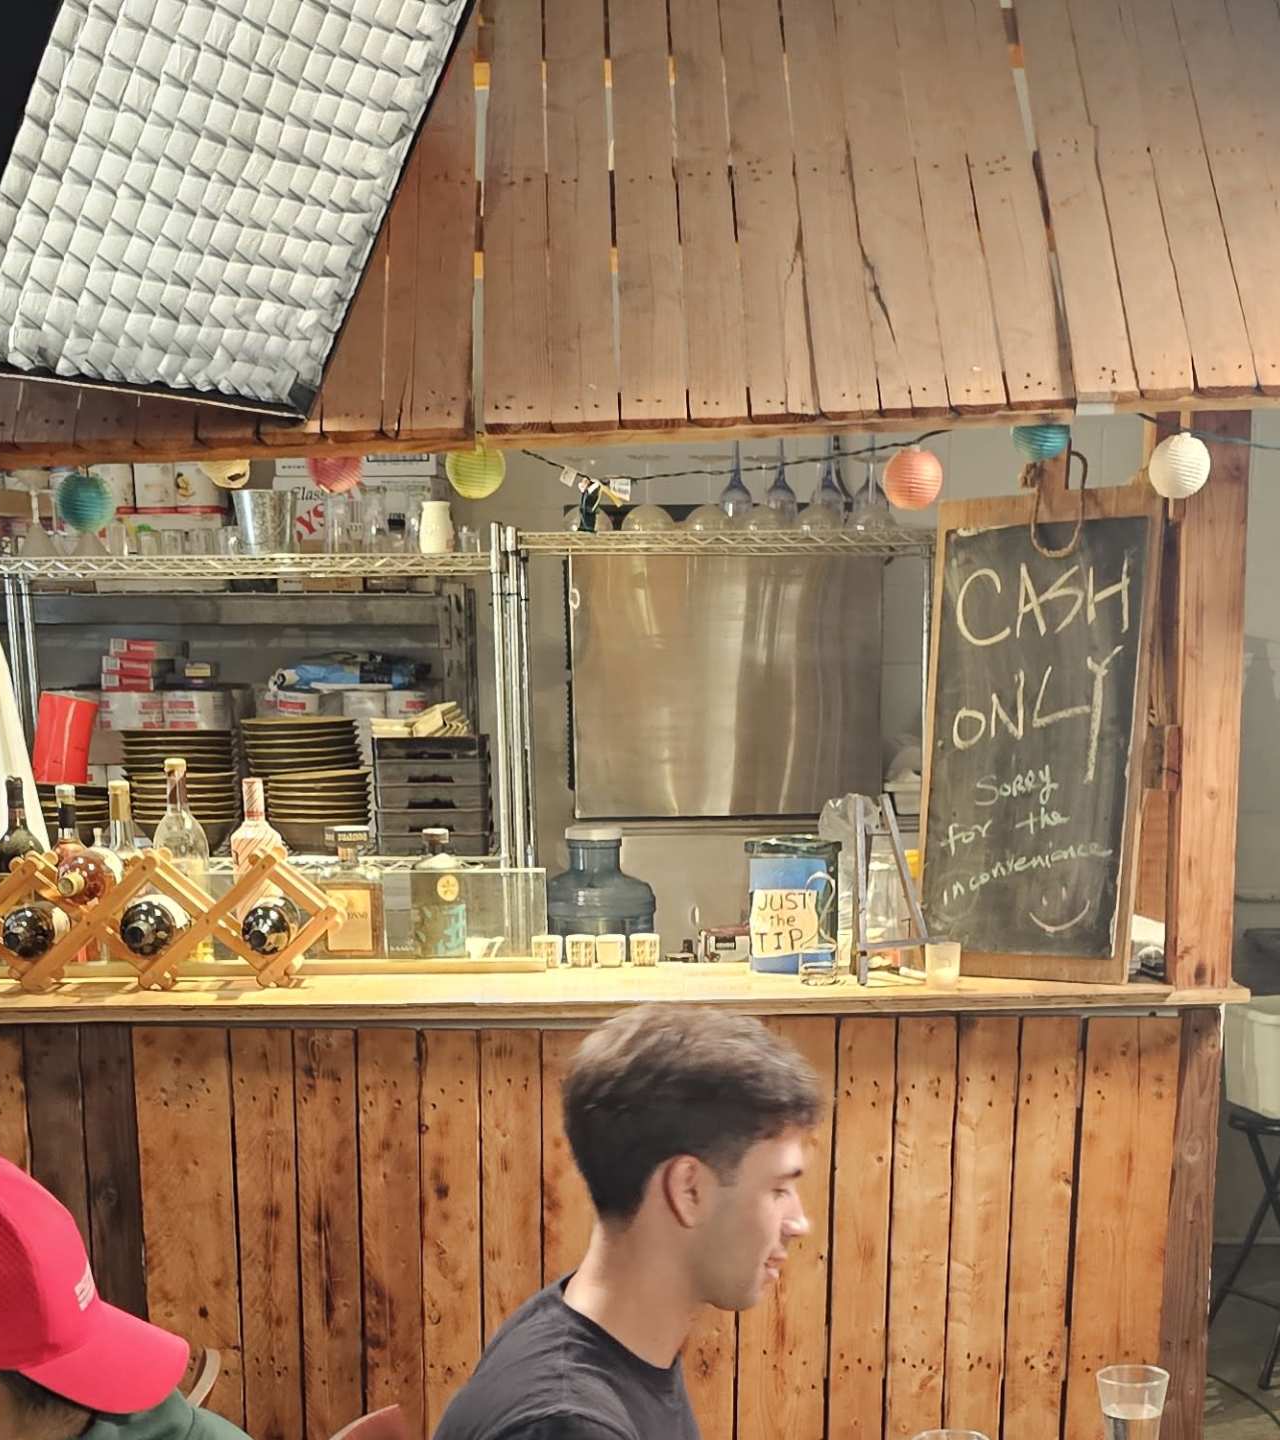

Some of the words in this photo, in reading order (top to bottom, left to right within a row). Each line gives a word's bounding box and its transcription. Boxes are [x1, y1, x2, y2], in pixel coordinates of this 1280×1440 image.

[956, 559, 1130, 646] CASH
[953, 645, 1123, 783] ONLY
[940, 819, 992, 856] for
[1015, 807, 1070, 835] the
[758, 892, 806, 911] JUST
[944, 841, 1112, 906] inconvenience
[755, 928, 803, 951] TIP
